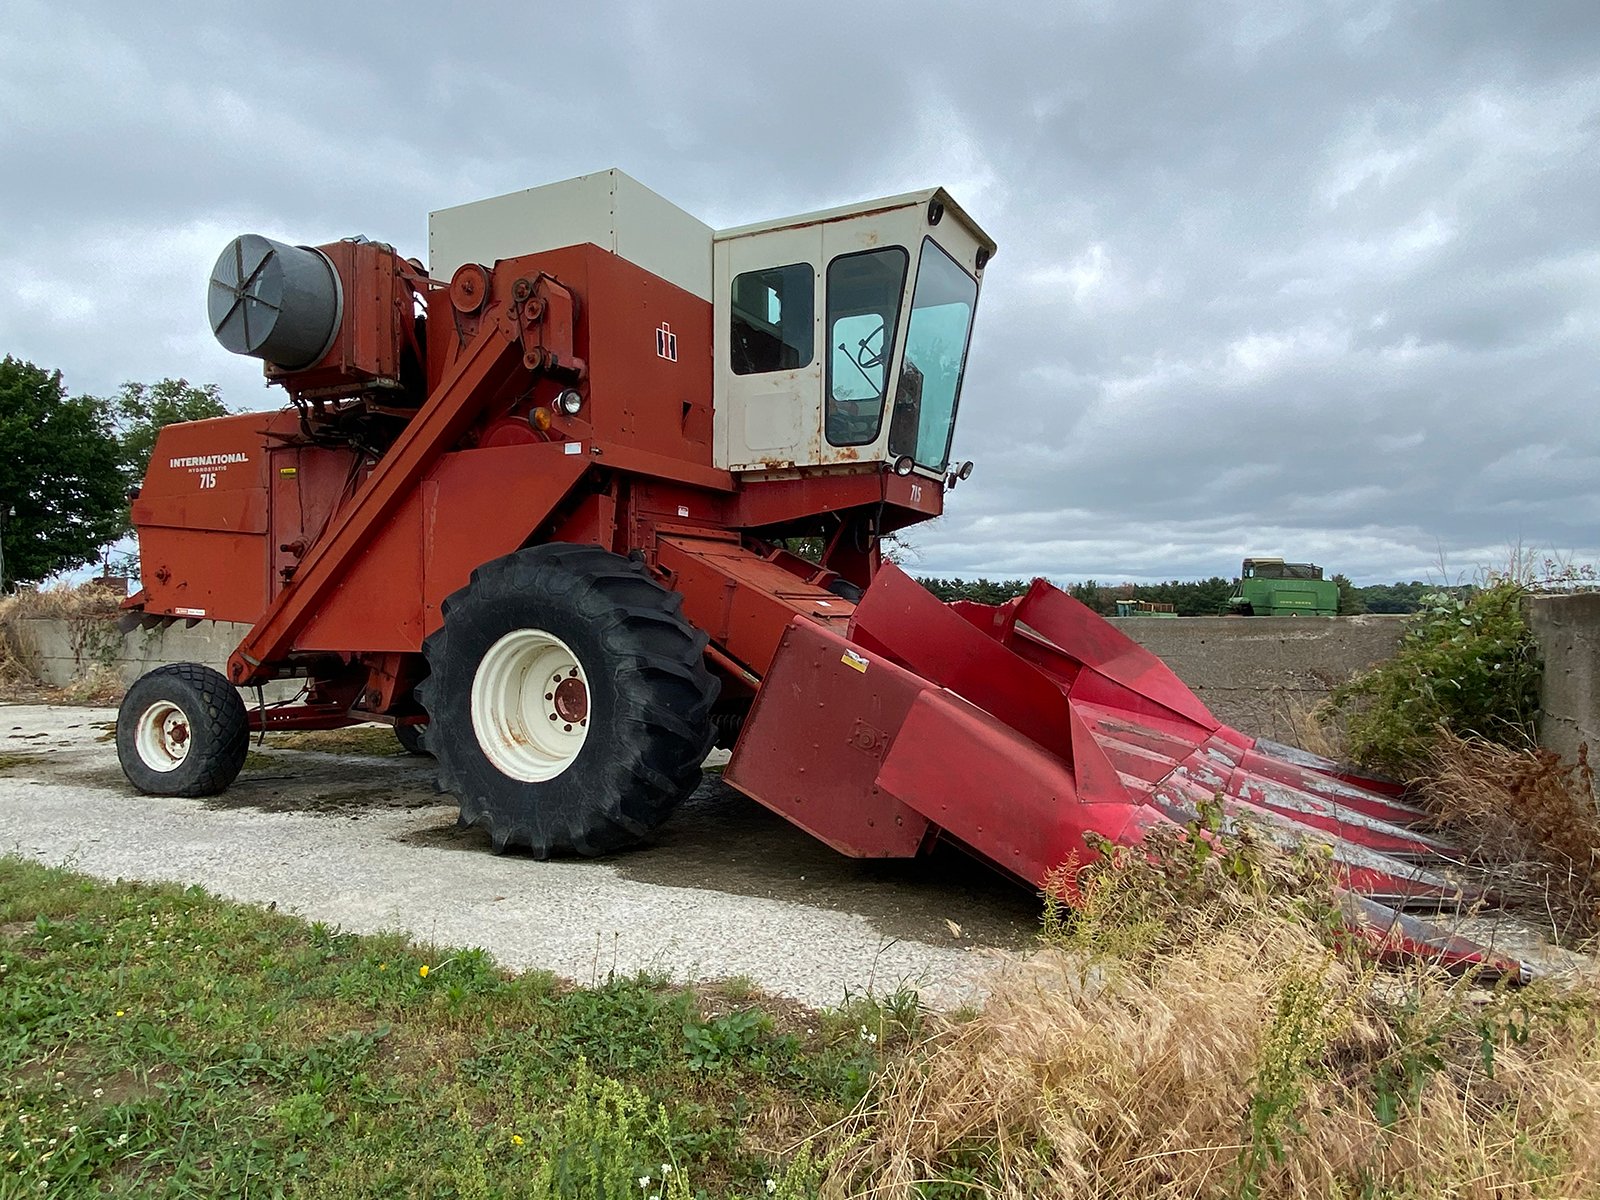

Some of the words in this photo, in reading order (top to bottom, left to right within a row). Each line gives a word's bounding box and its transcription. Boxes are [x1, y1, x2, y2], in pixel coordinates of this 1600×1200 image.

[170, 453, 249, 468] INTERNATIONAL
[200, 473, 217, 489] 715
[910, 484, 922, 503] 715
